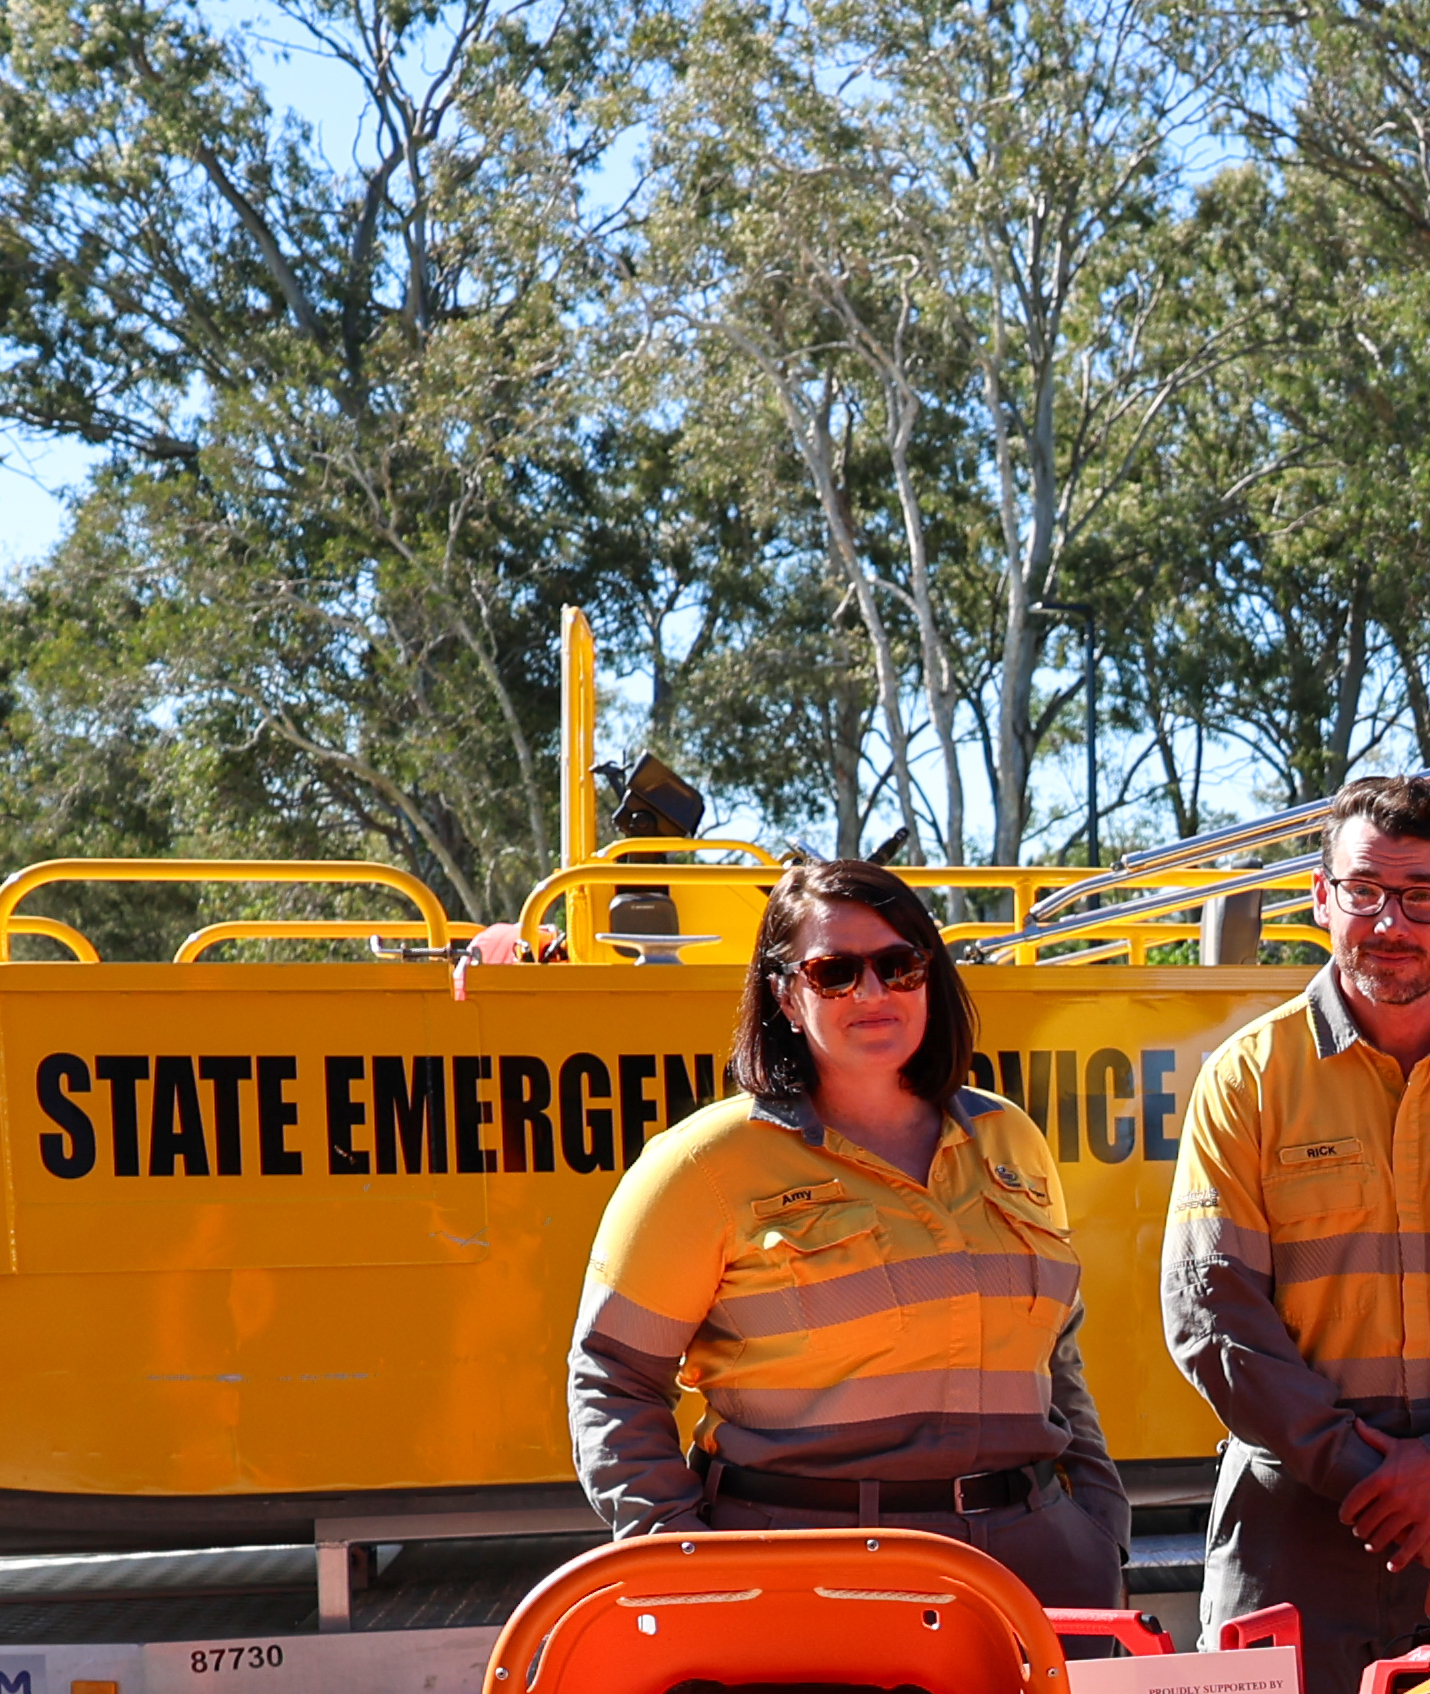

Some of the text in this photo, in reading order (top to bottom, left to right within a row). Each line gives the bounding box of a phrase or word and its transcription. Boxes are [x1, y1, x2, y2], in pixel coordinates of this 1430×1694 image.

[36, 1049, 1176, 1179] STATE EMERGEN VICE
[1307, 1146, 1336, 1157] RICK
[781, 1189, 812, 1206] Amy
[190, 1644, 284, 1673] 87730
[1203, 1682, 1267, 1694] SUPPORTED
[1269, 1680, 1284, 1690] BY
